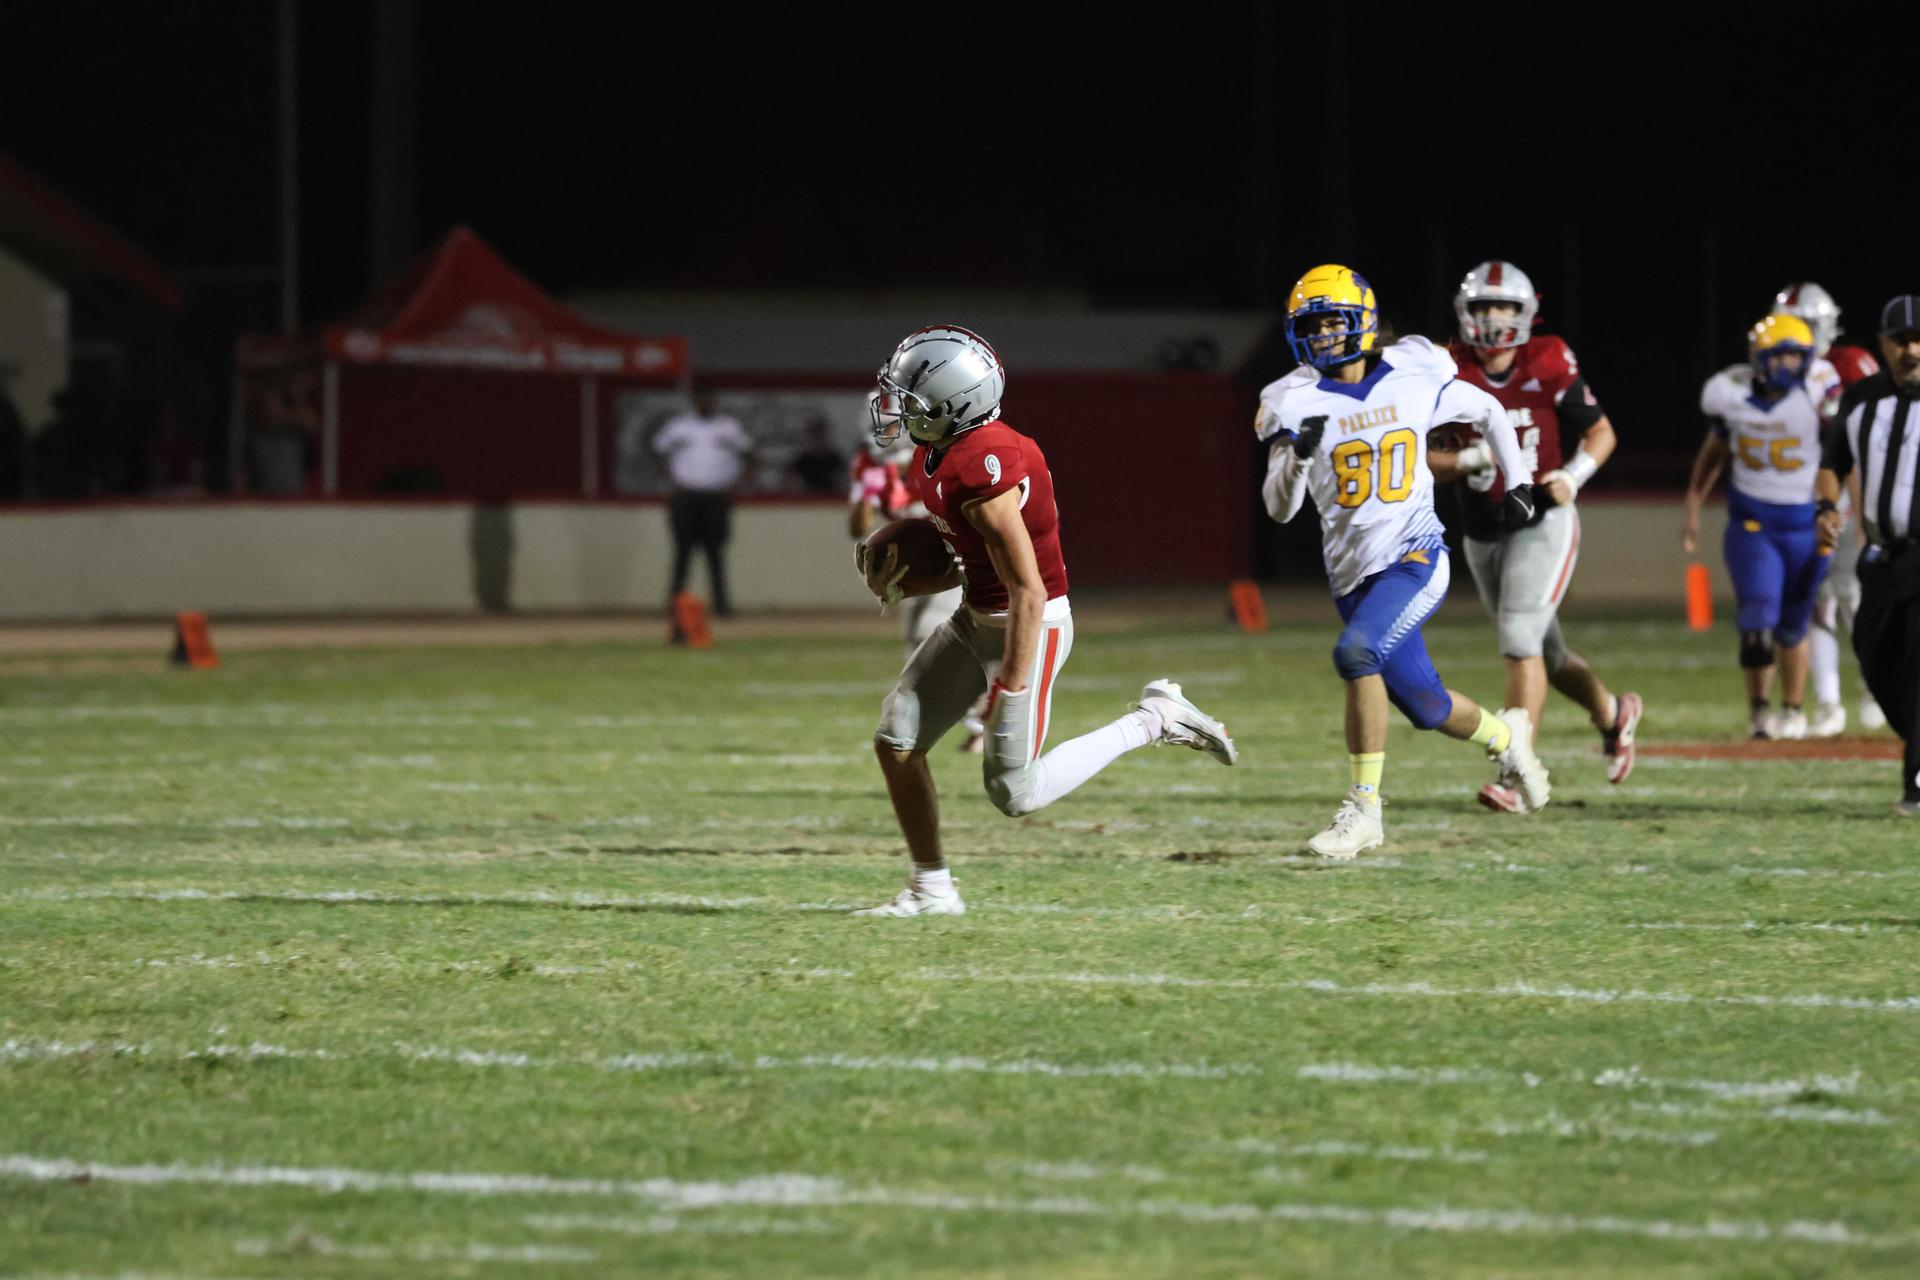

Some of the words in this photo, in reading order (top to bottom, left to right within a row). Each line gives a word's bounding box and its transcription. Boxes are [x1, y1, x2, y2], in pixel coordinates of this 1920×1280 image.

[1337, 405, 1398, 436] PARLIER
[984, 454, 1002, 486] 9
[1330, 427, 1418, 509] 80
